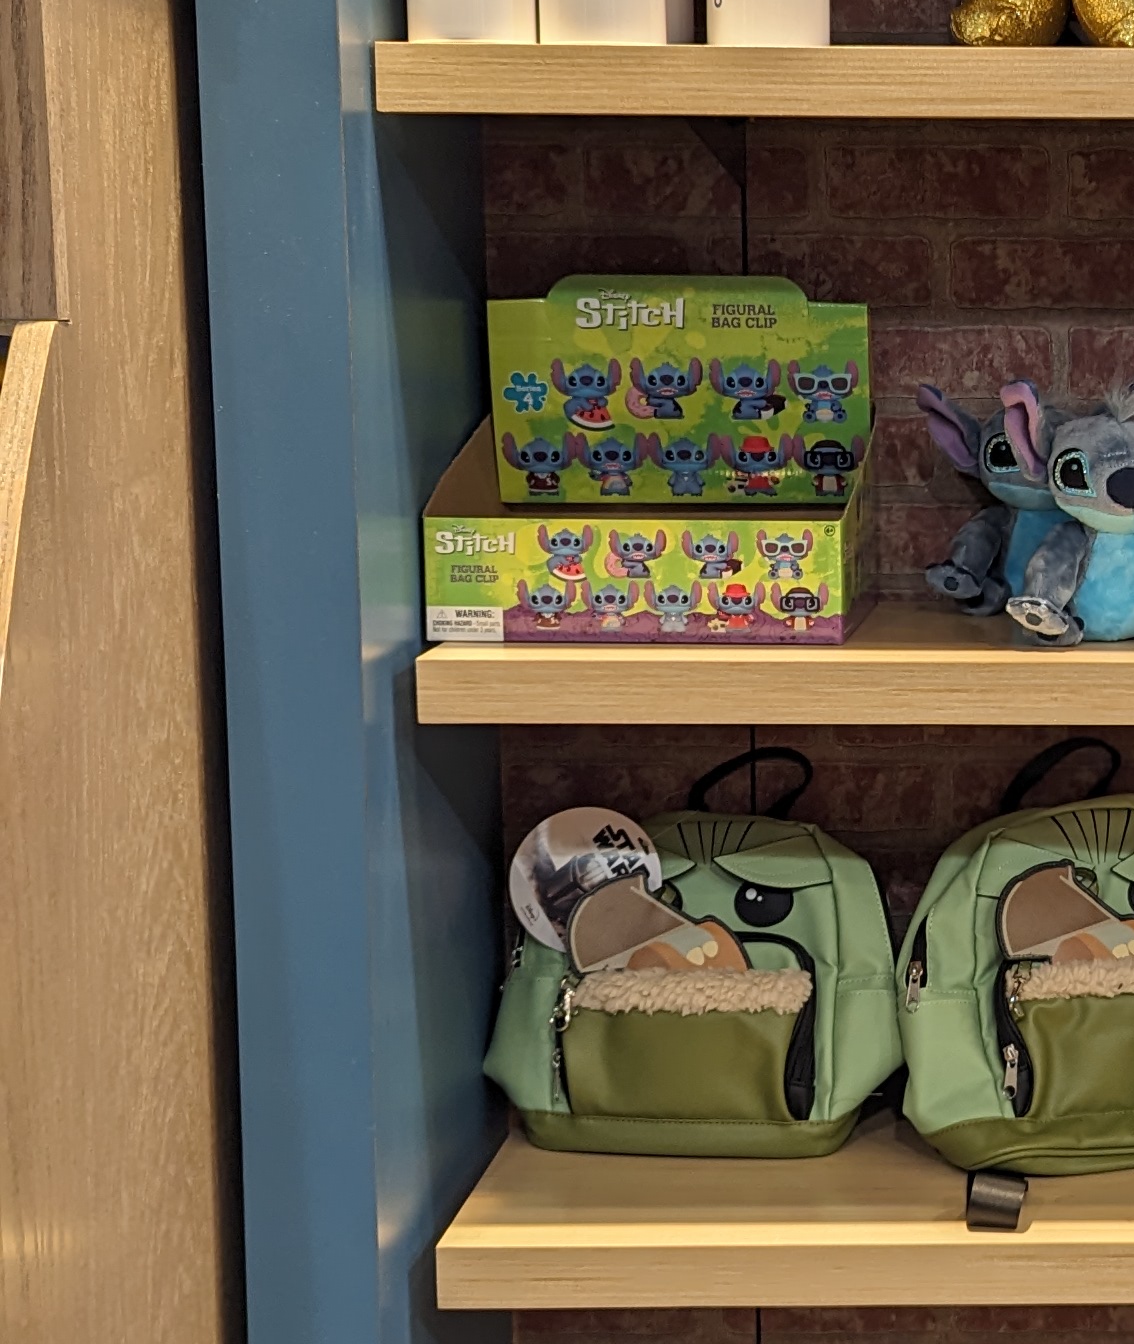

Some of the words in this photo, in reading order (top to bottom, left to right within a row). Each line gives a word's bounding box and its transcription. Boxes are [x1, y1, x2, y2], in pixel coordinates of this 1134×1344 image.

[712, 304, 776, 316] FIGURAL
[711, 317, 741, 329] BAG
[745, 317, 778, 329] CLIP
[523, 393, 534, 405] 4
[451, 564, 498, 574] FIGURAL
[450, 574, 473, 583] BAG
[475, 574, 500, 584] CLIP
[454, 609, 496, 619] WARNING:
[593, 828, 631, 879] WAR
